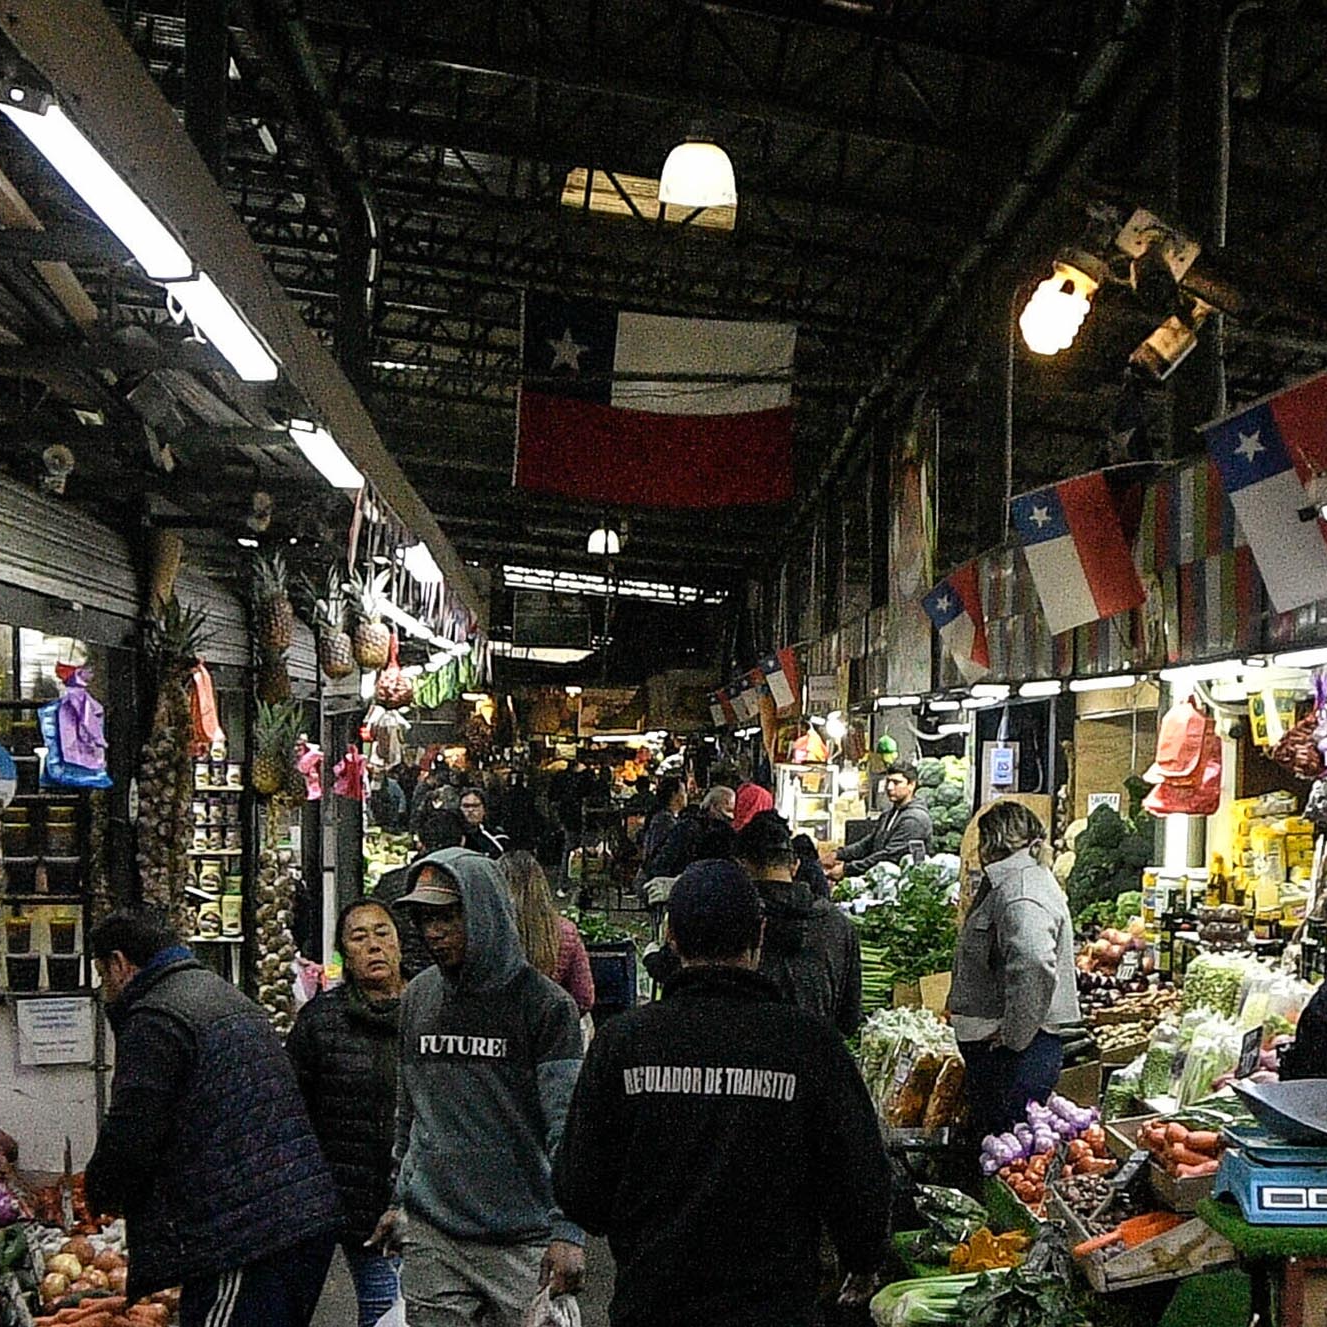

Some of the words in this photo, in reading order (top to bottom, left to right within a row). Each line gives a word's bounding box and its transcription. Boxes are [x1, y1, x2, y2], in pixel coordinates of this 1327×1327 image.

[623, 1066, 702, 1095] REGULADOR
[704, 1067, 723, 1095] DE
[725, 1067, 797, 1101] TRANSITO
